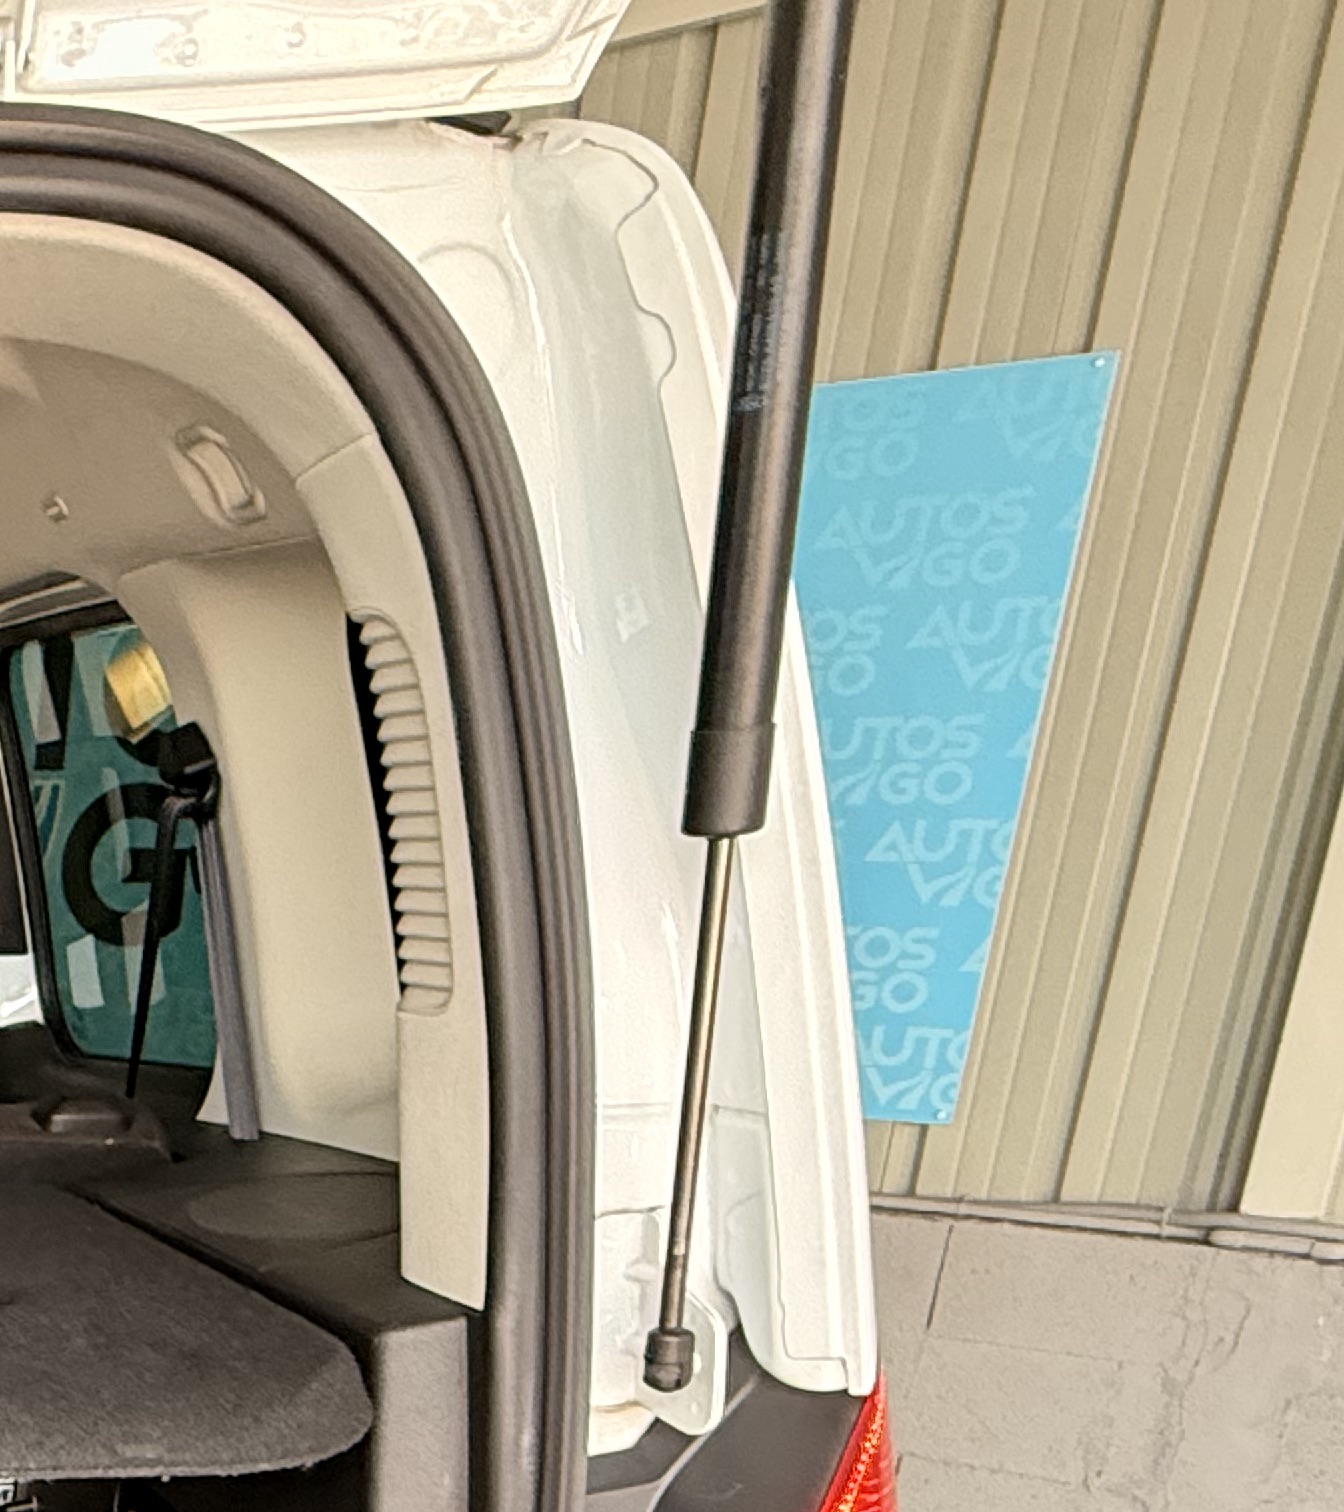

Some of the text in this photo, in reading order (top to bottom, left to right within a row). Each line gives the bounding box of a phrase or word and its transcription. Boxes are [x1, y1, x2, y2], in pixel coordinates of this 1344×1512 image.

[815, 432, 919, 479] GO
[813, 486, 1036, 554] AUTOS
[853, 537, 1021, 590] VIGO
[825, 712, 986, 760] UTOS
[852, 970, 928, 1013] GO
